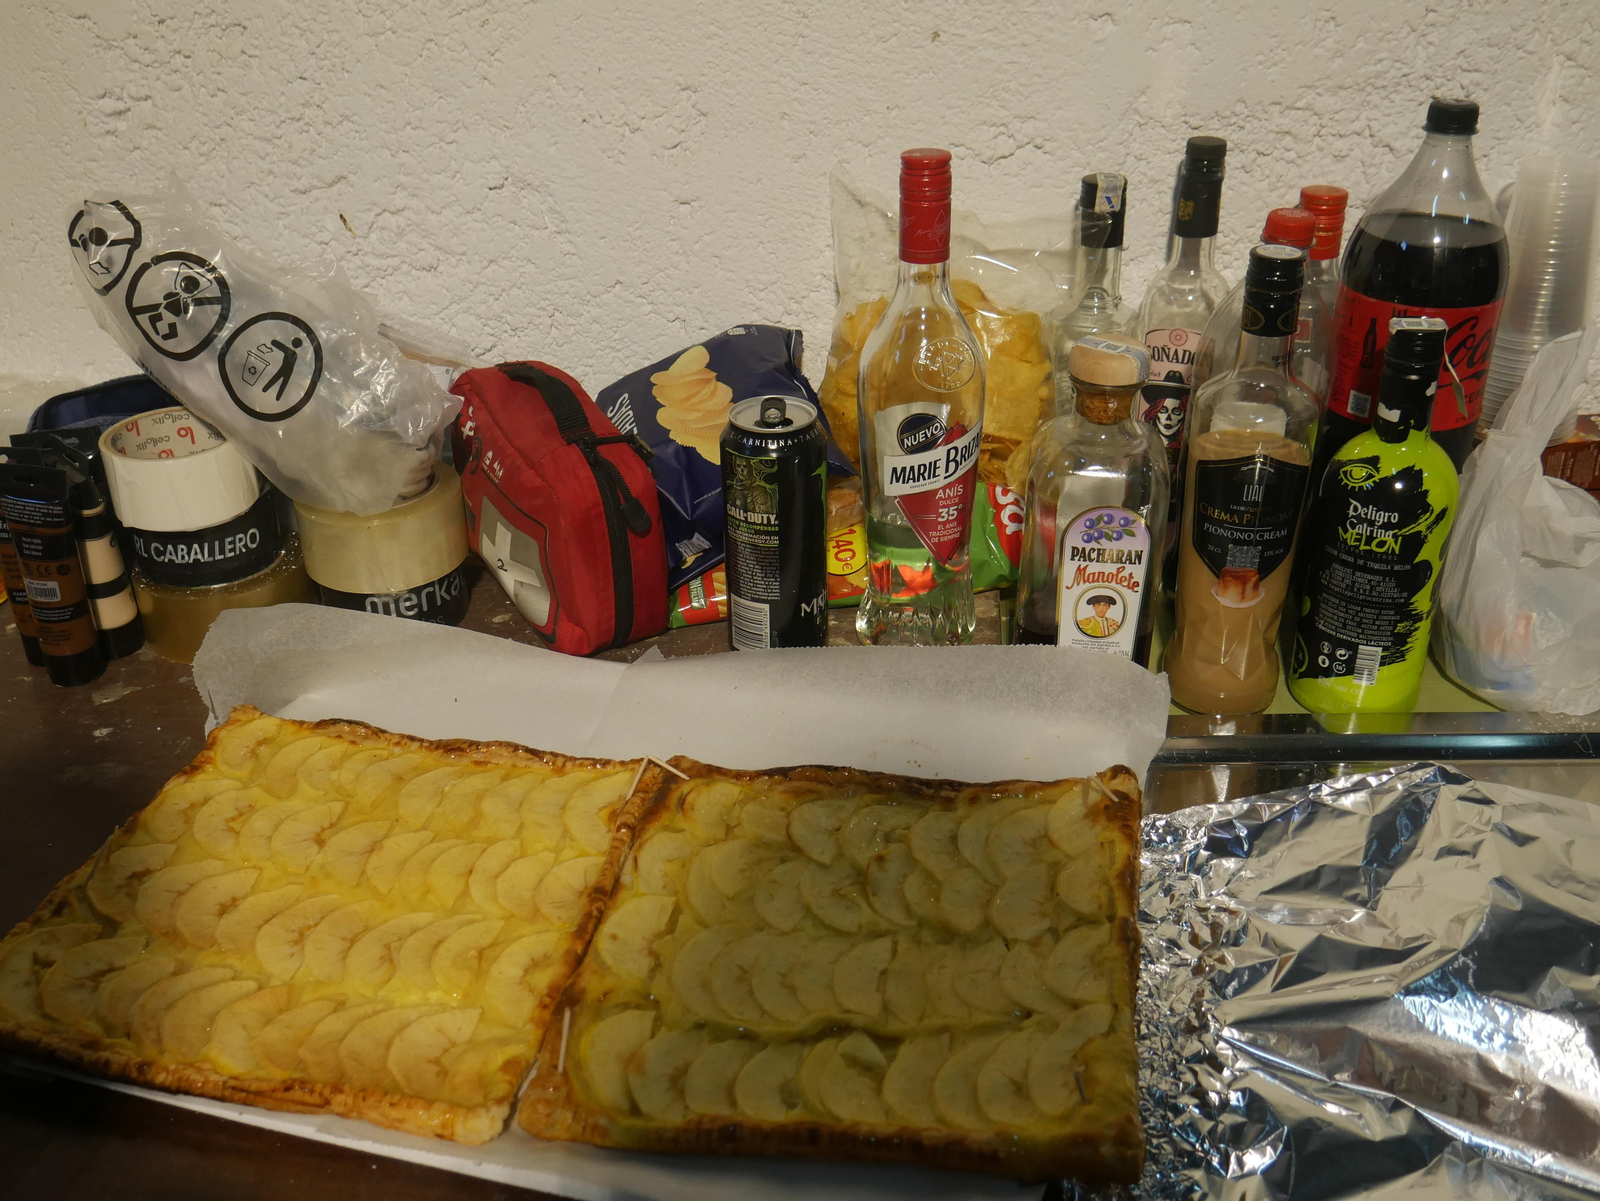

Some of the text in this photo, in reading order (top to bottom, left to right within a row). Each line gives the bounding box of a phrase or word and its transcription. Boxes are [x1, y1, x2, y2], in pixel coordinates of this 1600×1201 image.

[903, 422, 941, 449] NUEVO
[890, 458, 942, 485] MARIE
[935, 484, 964, 500] ANÍS
[939, 497, 960, 506] DULCE
[1199, 502, 1239, 524] CREMA
[1346, 497, 1399, 526] Peligro
[1204, 522, 1288, 541] PIONONO CREAM
[1338, 526, 1402, 555] MELON
[150, 528, 260, 564] CABALLERO
[1070, 546, 1144, 566] PACHARAN
[1065, 564, 1140, 593] Manolete
